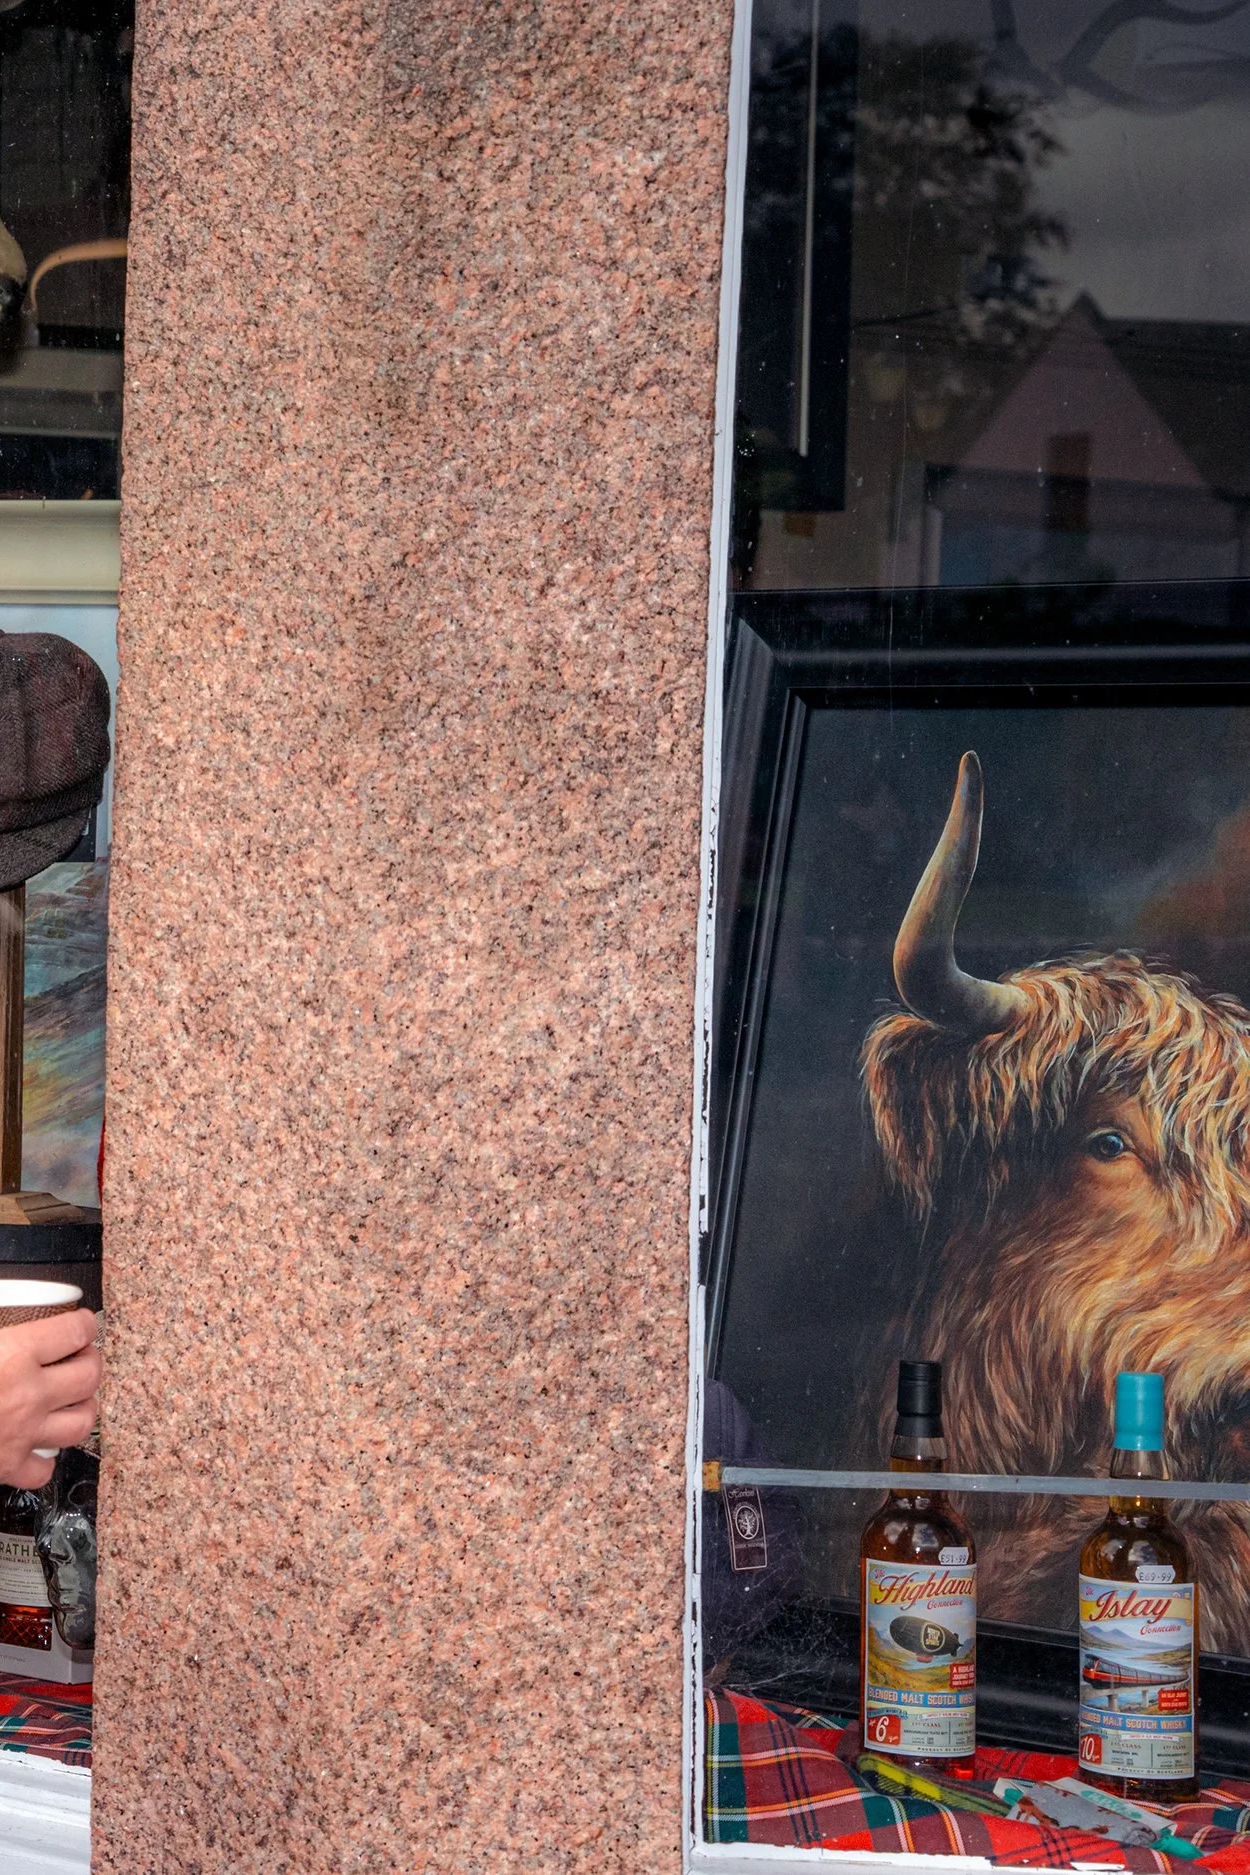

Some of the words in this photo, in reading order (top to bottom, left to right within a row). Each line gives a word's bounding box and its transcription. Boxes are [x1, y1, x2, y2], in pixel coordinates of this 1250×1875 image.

[874, 1570, 975, 1610] Highland
[927, 1599, 963, 1609] Connection
[1089, 1589, 1173, 1624] Islay
[1140, 1624, 1182, 1635] Connection
[869, 1688, 898, 1702] BLENDED
[901, 1692, 924, 1704] MALT
[927, 1694, 956, 1705] SCOTCH
[875, 1716, 889, 1742] 6
[1103, 1714, 1123, 1727] MALT
[1126, 1719, 1157, 1729] SCOTCH
[1081, 1735, 1095, 1760] 10
